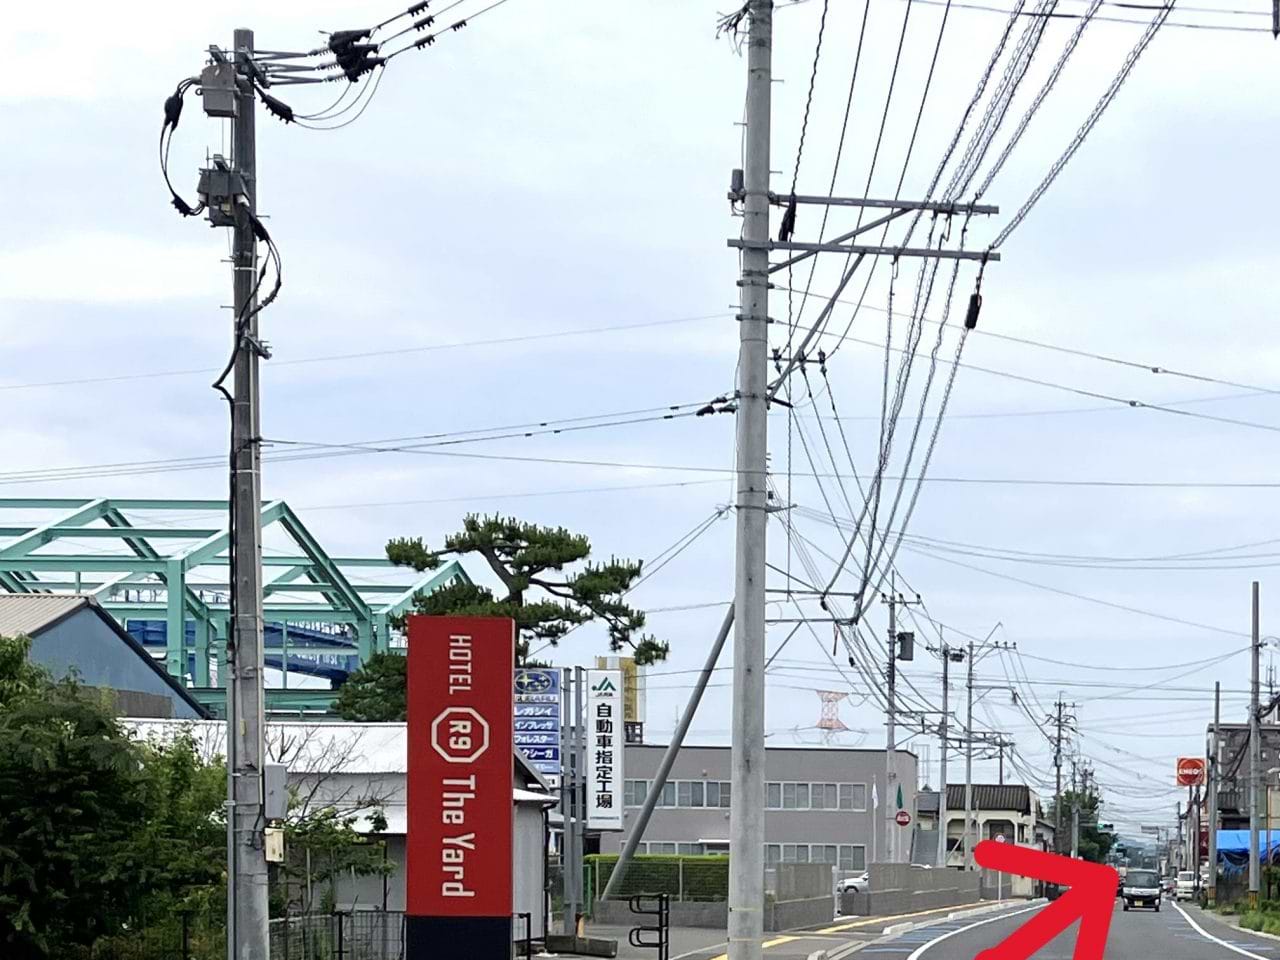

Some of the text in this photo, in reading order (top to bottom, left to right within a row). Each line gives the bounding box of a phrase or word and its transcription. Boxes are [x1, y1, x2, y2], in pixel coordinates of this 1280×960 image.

[442, 634, 476, 897] HOTEL R9 The Yard
[514, 735, 554, 744] フォレスター
[521, 748, 554, 759] クシーガ
[595, 703, 613, 809] 自動車指定工場
